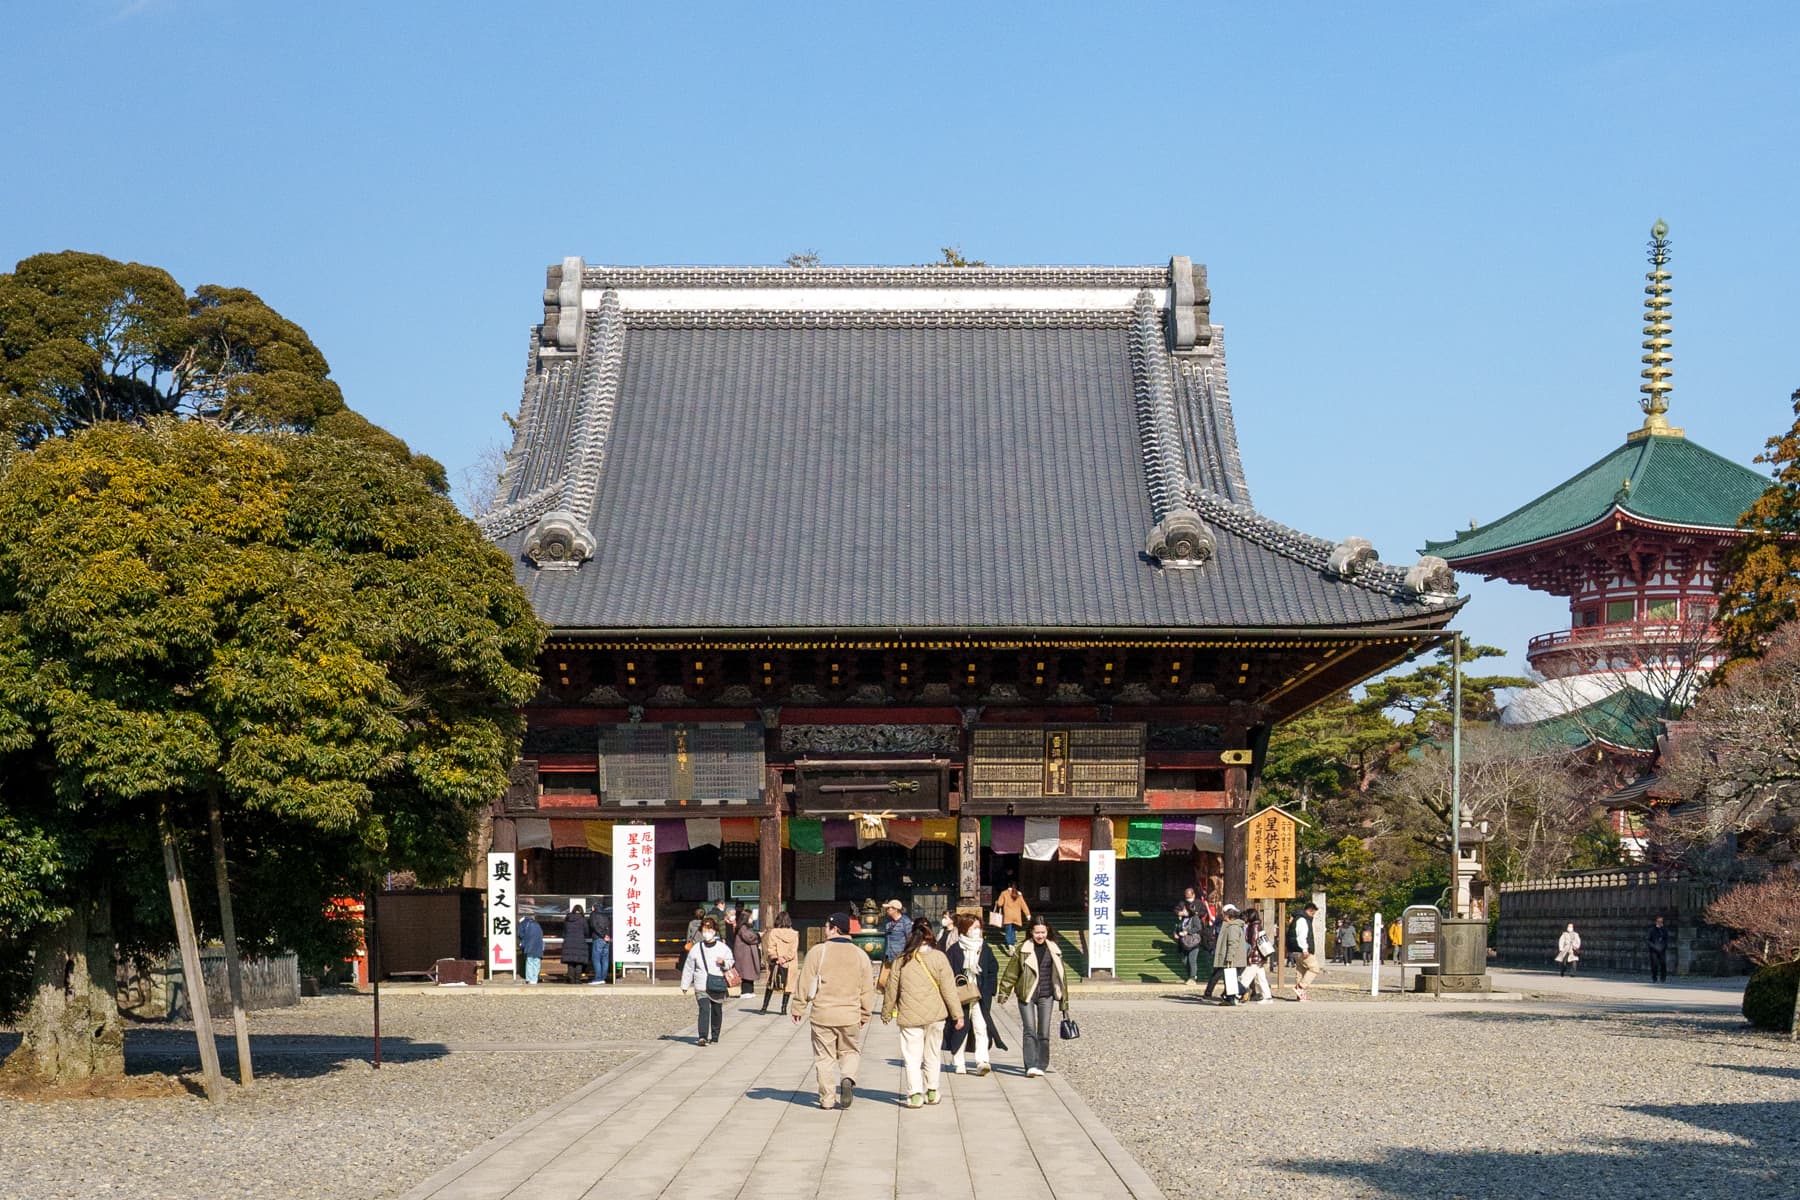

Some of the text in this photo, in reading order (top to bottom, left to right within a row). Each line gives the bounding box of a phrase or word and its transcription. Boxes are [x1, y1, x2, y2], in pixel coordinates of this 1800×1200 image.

[641, 831, 653, 868] 厄除け
[963, 839, 975, 893] 光明堂
[492, 859, 512, 936] 奥之院
[626, 832, 641, 956] 星まつり御守札受場
[1093, 873, 1111, 936] 愛染明王
